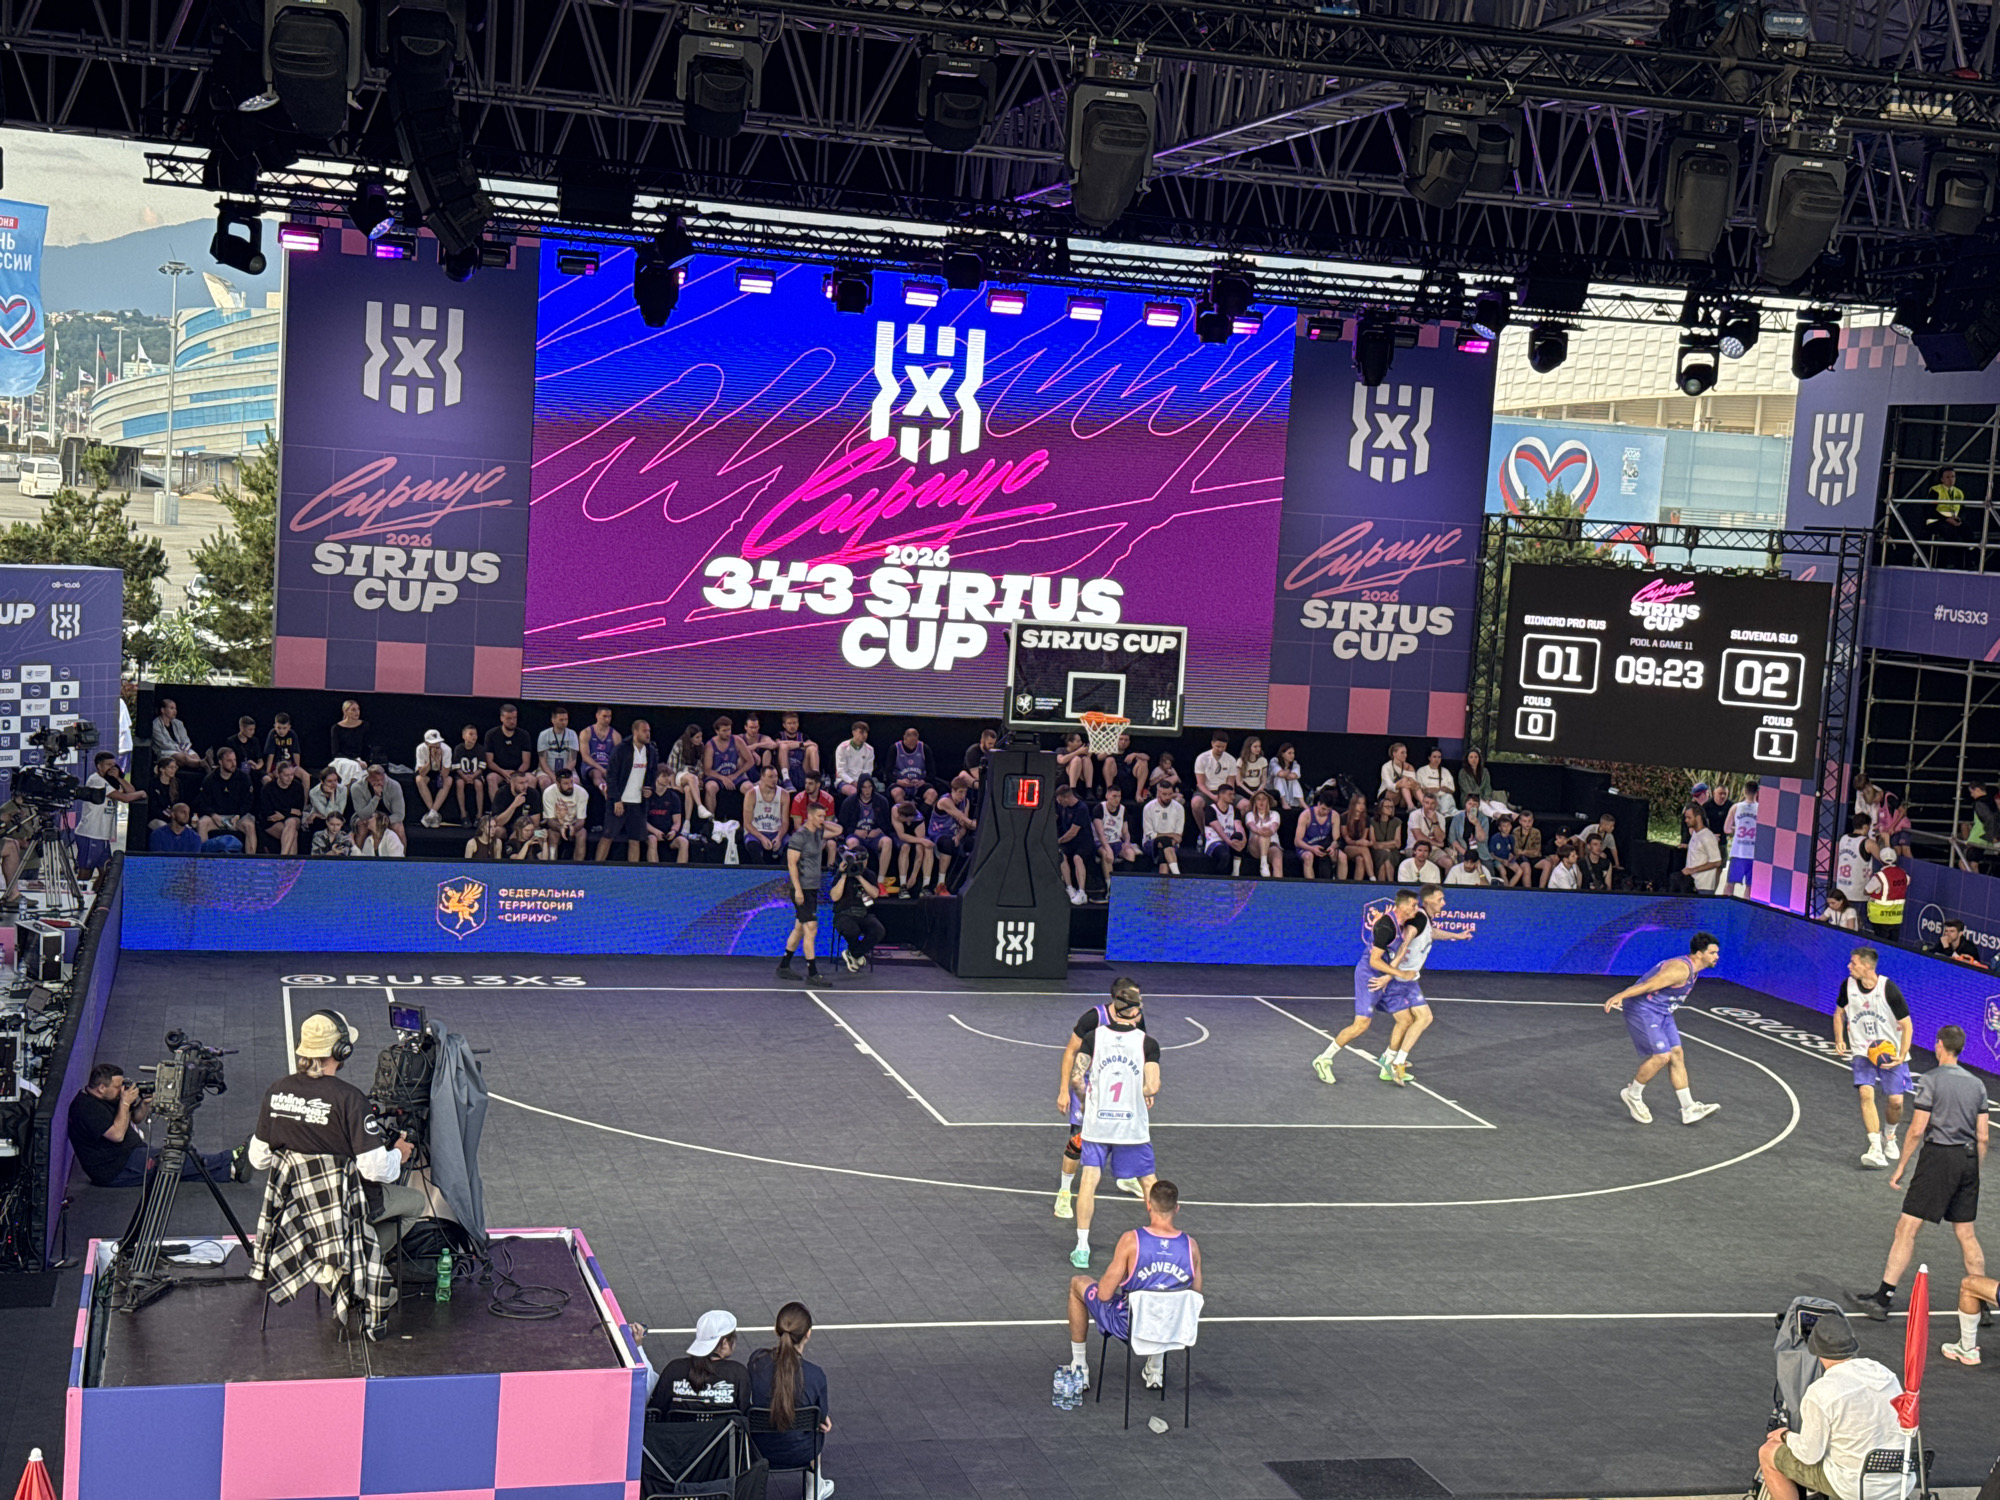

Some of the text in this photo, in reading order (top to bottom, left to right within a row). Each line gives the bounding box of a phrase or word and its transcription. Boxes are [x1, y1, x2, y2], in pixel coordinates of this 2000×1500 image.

[386, 533, 432, 547] 2026
[312, 542, 502, 584] SIRIUS
[884, 545, 950, 568] 2026
[354, 578, 458, 612] CUP
[864, 566, 1125, 624] SIRIUS
[1361, 590, 1399, 602] 2026
[1300, 599, 1455, 636] SIRIUS
[1629, 602, 1700, 620] SIRIUS
[1566, 618, 1586, 628] PRO
[1586, 620, 1606, 630] RUS
[1643, 614, 1684, 632] CUP
[841, 616, 988, 671] CUP
[1020, 629, 1178, 654] SIRIUS CUP
[1333, 630, 1419, 662] CUP
[1630, 638, 1694, 650] POOL A GAME 11
[1730, 629, 1798, 645] SLOVENIA SLO
[1537, 645, 1582, 682] 01
[1614, 654, 1704, 690] 09:23
[1734, 660, 1790, 698] 02
[1523, 695, 1552, 707] FOULS
[1528, 713, 1542, 735] 0
[1762, 715, 1794, 728] FOULS
[1769, 734, 1782, 756] 1
[1018, 778, 1039, 807] 10
[1736, 826, 1756, 840] 34
[498, 888, 584, 898] ФЕДЕРАЛЬНАЯ
[498, 900, 573, 910] ТЕРРИТОРИЯ
[498, 913, 558, 923] «СИРИУС»
[1922, 918, 1942, 934] РФБ
[280, 974, 588, 986] @RUS3X3
[1110, 1082, 1124, 1102] 1
[1137, 1261, 1190, 1282] SLOVENIA
